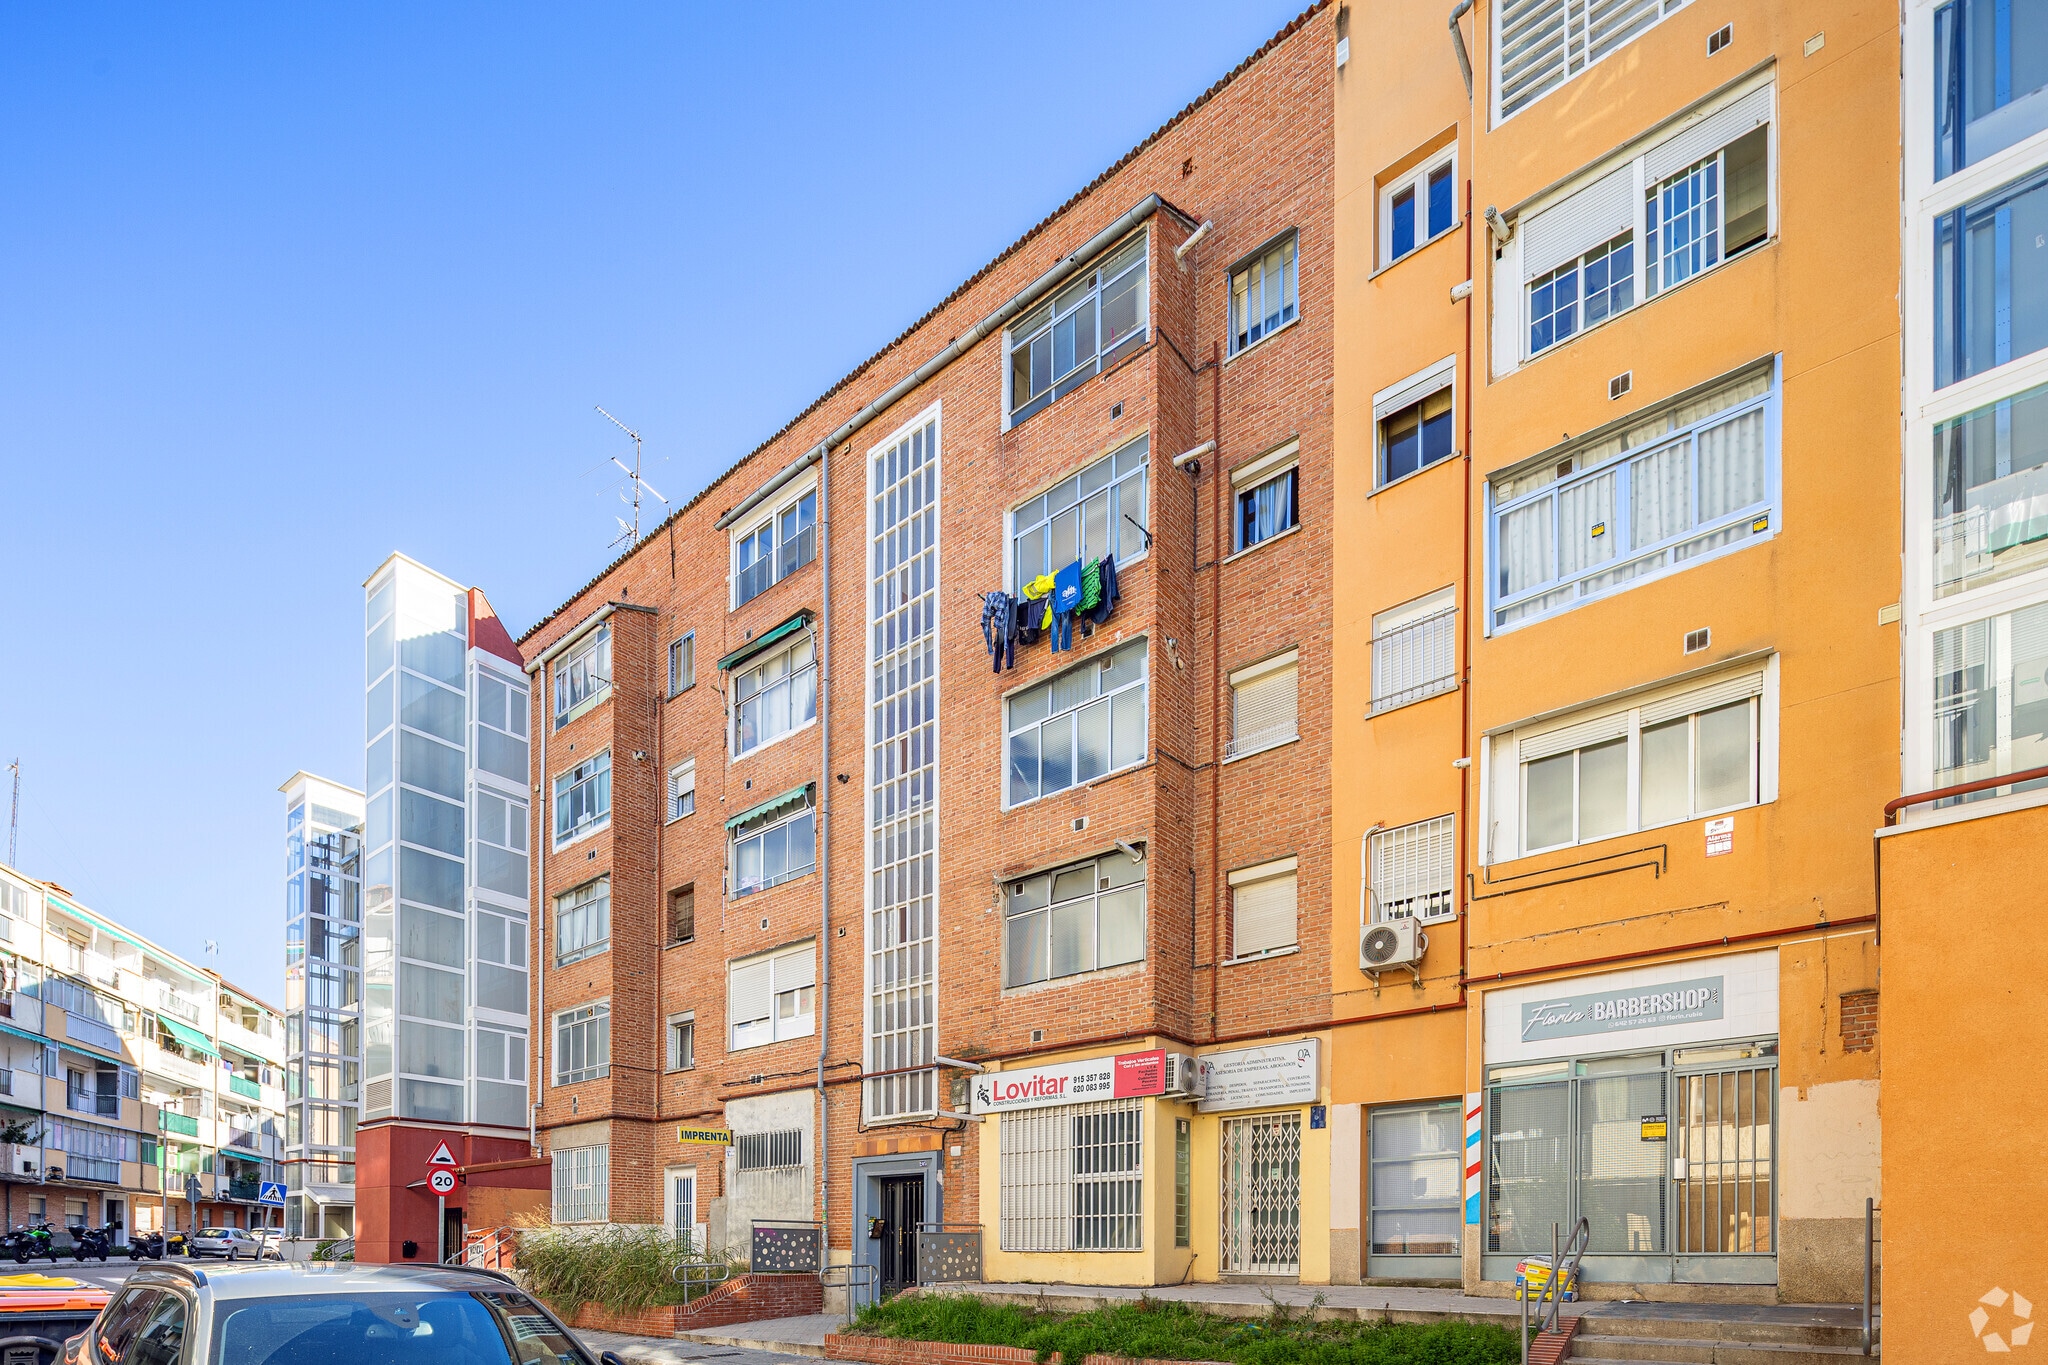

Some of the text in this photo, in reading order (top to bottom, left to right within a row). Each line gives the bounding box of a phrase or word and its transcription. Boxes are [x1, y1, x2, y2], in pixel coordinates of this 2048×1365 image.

[1522, 988, 1712, 1036] Florin BARBERSHOP
[1666, 1012, 1703, 1021] florin.rubio
[1073, 1072, 1111, 1084] 915 357 828
[993, 1074, 1068, 1101] Lovitar
[1073, 1082, 1110, 1093] 620 083 995
[993, 1098, 1030, 1106] CONSTRUCCIONES
[682, 1130, 728, 1141] IMPRENTA
[434, 1176, 452, 1186] 20
